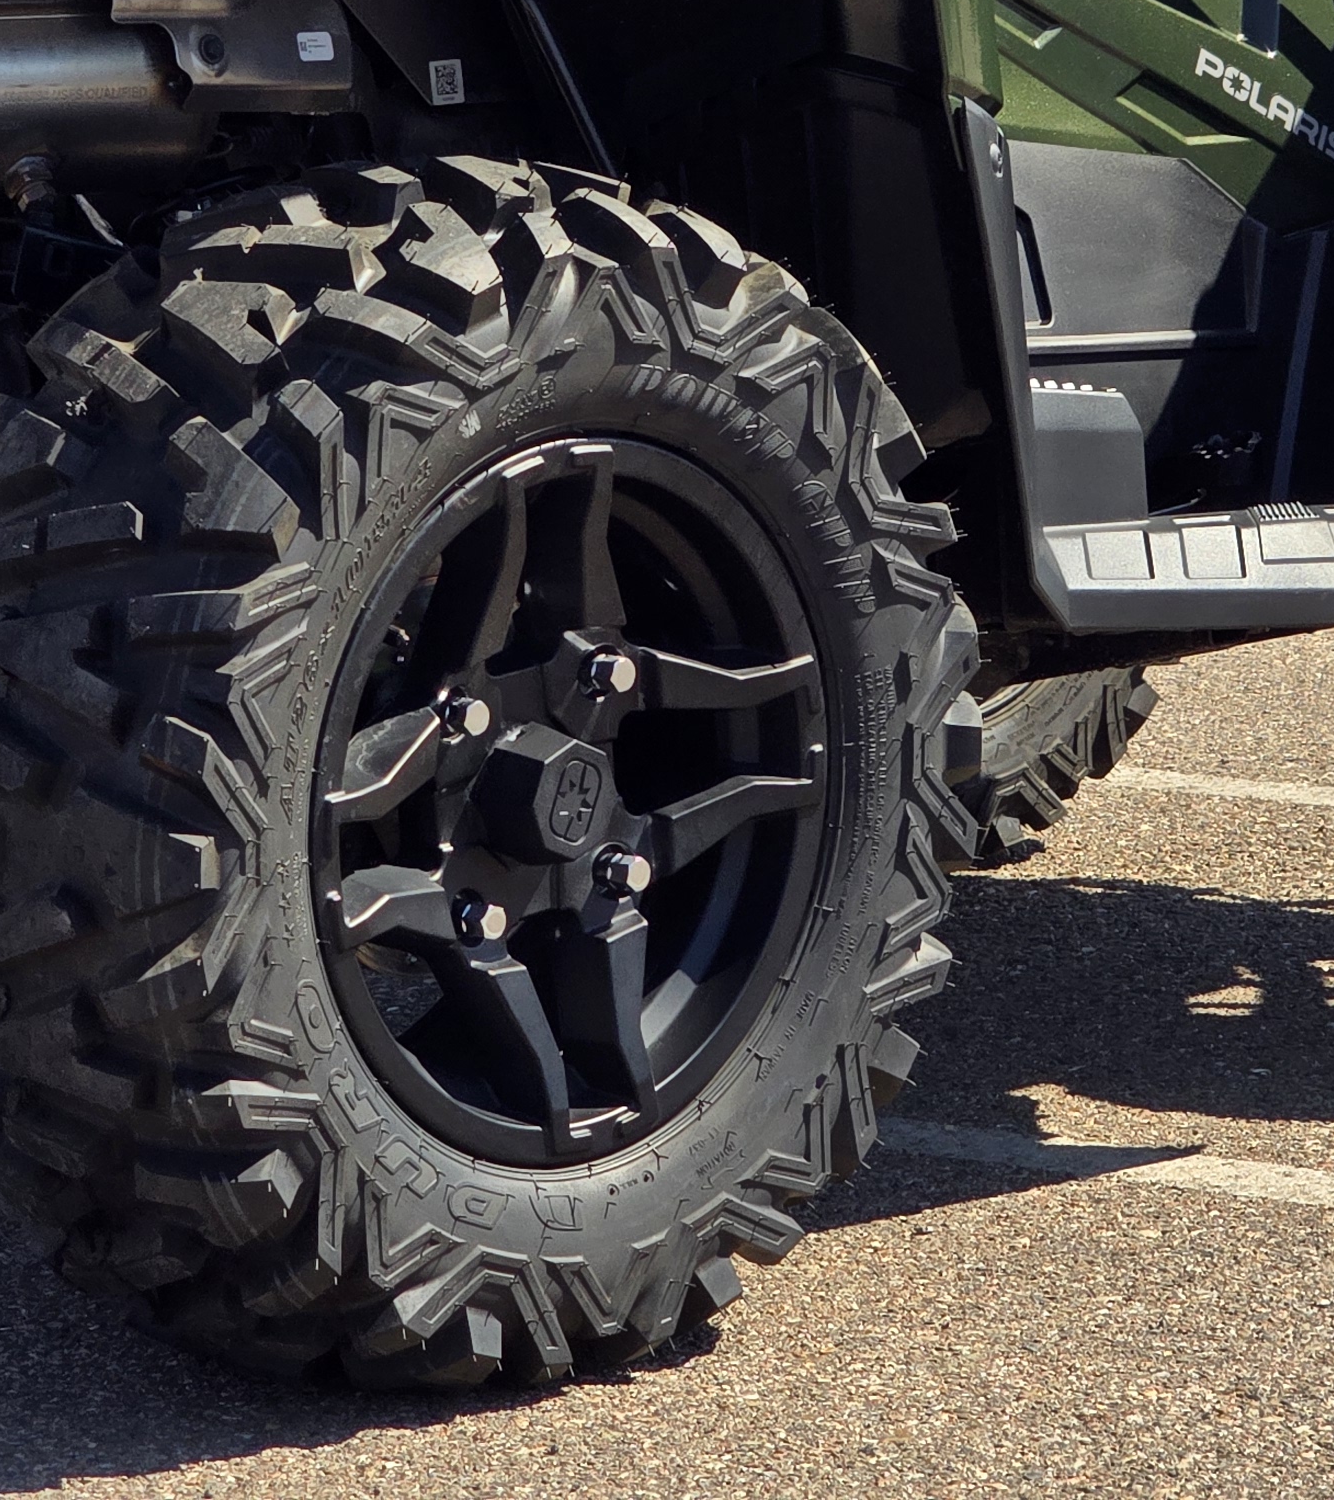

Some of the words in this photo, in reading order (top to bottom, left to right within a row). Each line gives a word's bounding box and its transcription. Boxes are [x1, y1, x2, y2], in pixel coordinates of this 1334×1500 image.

[624, 361, 797, 460] POWER
[793, 988, 815, 1023] MADE
[782, 1022, 797, 1042] IN
[755, 1041, 786, 1083] TAIWAN
[293, 979, 508, 1233] DURO
[694, 1139, 737, 1179] ROTATION
